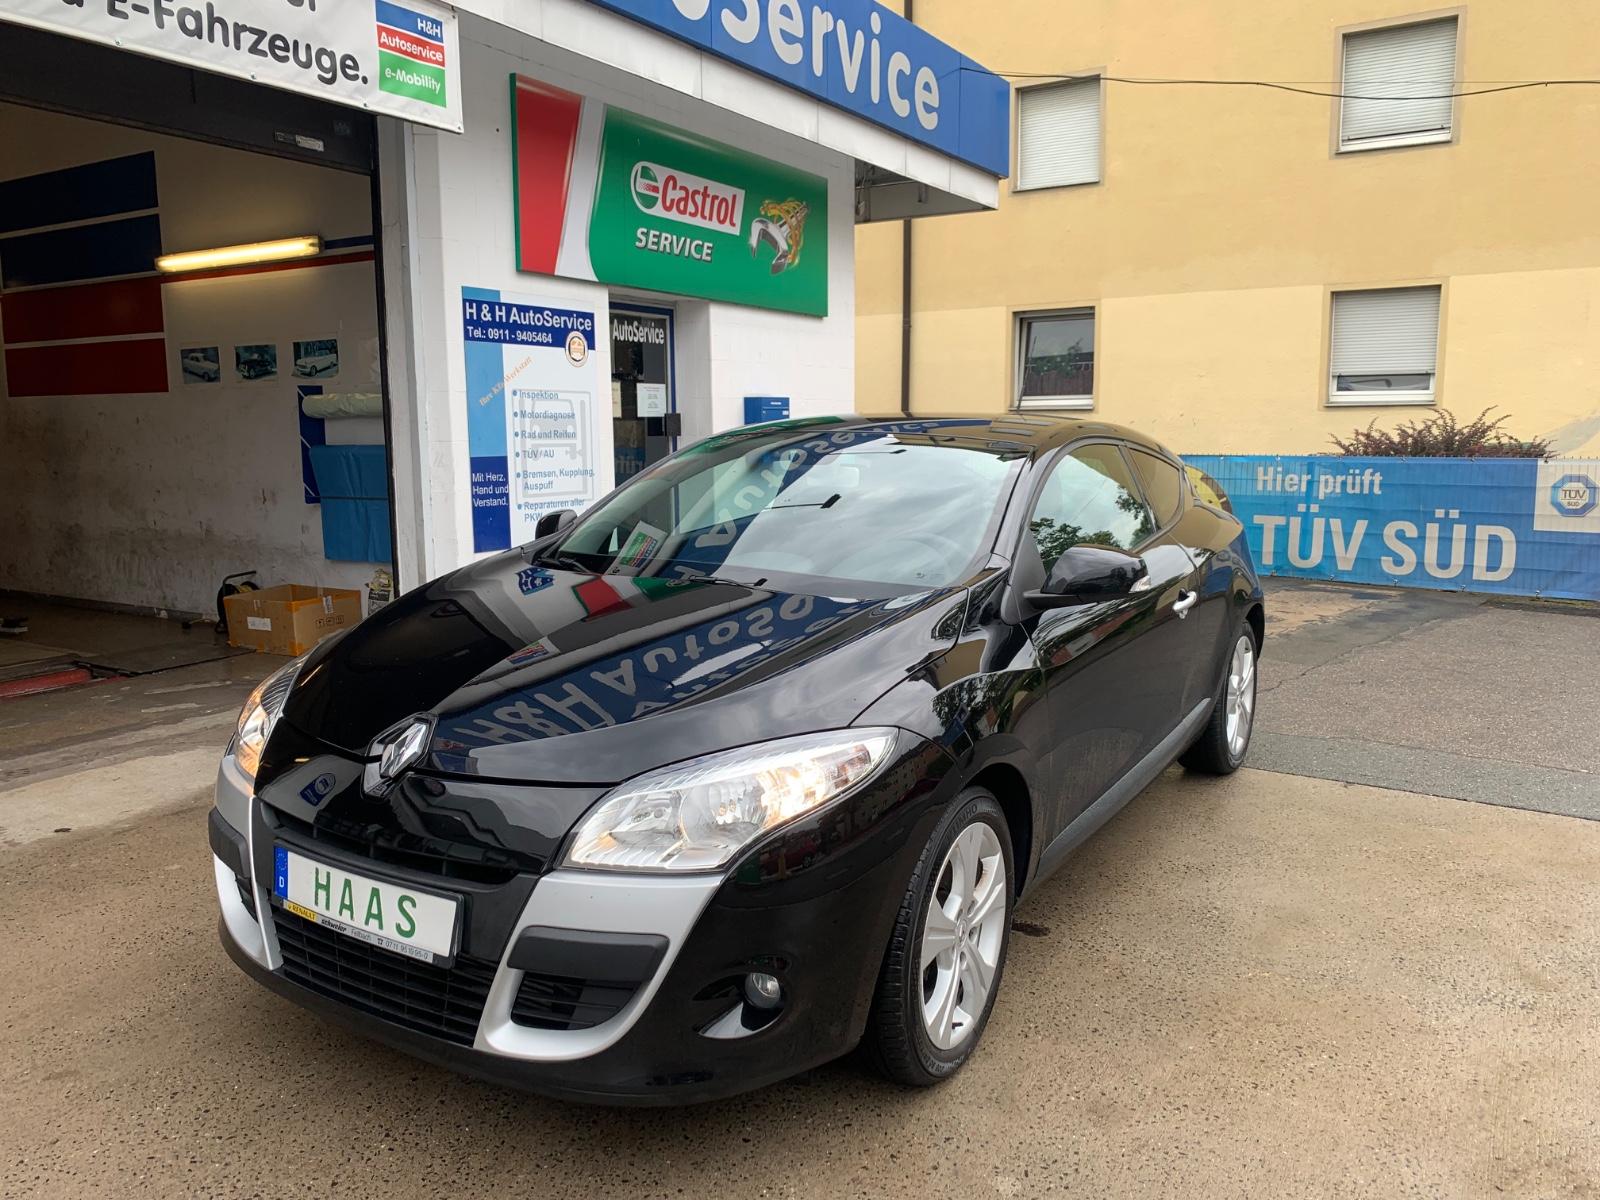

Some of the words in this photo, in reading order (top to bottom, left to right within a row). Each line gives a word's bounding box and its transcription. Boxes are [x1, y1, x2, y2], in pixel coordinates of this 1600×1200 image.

[417, 18, 441, 38] H&H
[380, 31, 444, 62] Autoservice
[384, 67, 441, 94] e-Mobility
[661, 174, 737, 228] Castrol
[635, 227, 714, 262] SERVICE
[465, 302, 477, 320] H
[480, 304, 491, 321] &
[495, 305, 506, 323] H
[509, 307, 592, 331] AutoService
[467, 326, 486, 339] Tel.:
[487, 328, 510, 340] 0911
[516, 330, 553, 344] 9405464
[612, 318, 665, 345] AutoService
[519, 389, 559, 400] Inspektion
[520, 409, 576, 421] Motordiagnose
[521, 430, 536, 439] Rad
[538, 430, 553, 439] und
[553, 429, 576, 439] Reifen
[522, 447, 538, 459] TÜV
[544, 449, 555, 458] AU
[472, 472, 485, 483] Mit
[1256, 466, 1312, 493] Hier
[1318, 468, 1383, 500] prüft
[472, 484, 493, 495] Hand
[495, 484, 509, 494] und
[524, 481, 553, 492] Auspuff
[473, 496, 509, 507] Verstand.
[524, 500, 568, 511] Reparaturen
[569, 498, 584, 507] aller
[1253, 503, 1369, 572] TÜV
[1380, 509, 1517, 583] SÜD
[278, 876, 284, 888] D
[314, 866, 417, 939] HAAS
[292, 904, 316, 921] RENAULT
